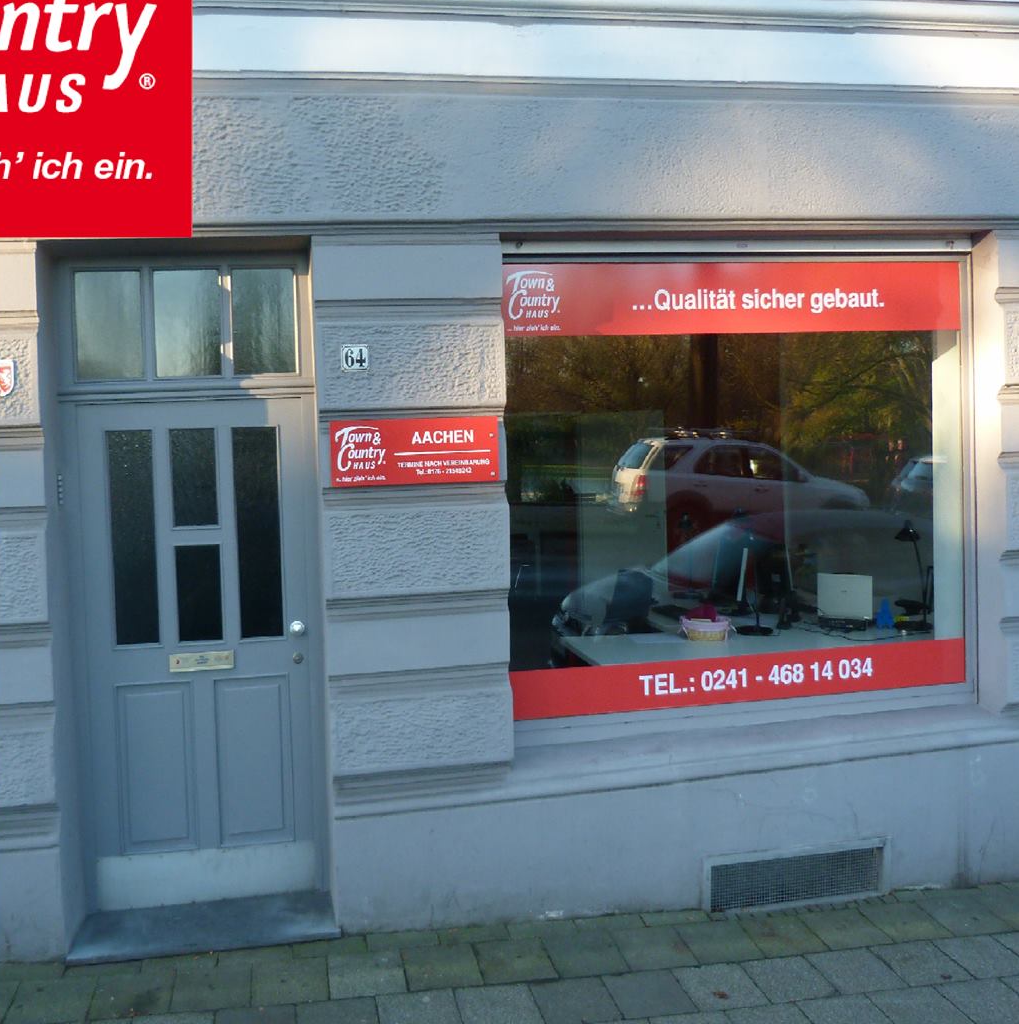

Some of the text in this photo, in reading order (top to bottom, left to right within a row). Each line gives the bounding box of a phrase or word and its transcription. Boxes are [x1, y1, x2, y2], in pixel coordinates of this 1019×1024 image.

[506, 270, 555, 296] Town &
[508, 289, 560, 320] Country
[741, 288, 804, 310] sicher
[810, 288, 885, 314] gebaut.
[525, 309, 549, 319] HAUS
[345, 348, 366, 368] 64
[335, 425, 381, 449] Town &
[411, 429, 474, 445] AACHEN
[337, 443, 386, 471] Country
[353, 461, 376, 470] HAUS
[424, 459, 442, 467] NACH
[639, 673, 695, 696] TEL.:
[700, 668, 747, 692] 0241
[768, 663, 804, 685] 468
[810, 660, 833, 681] 14
[838, 657, 873, 679] 034
